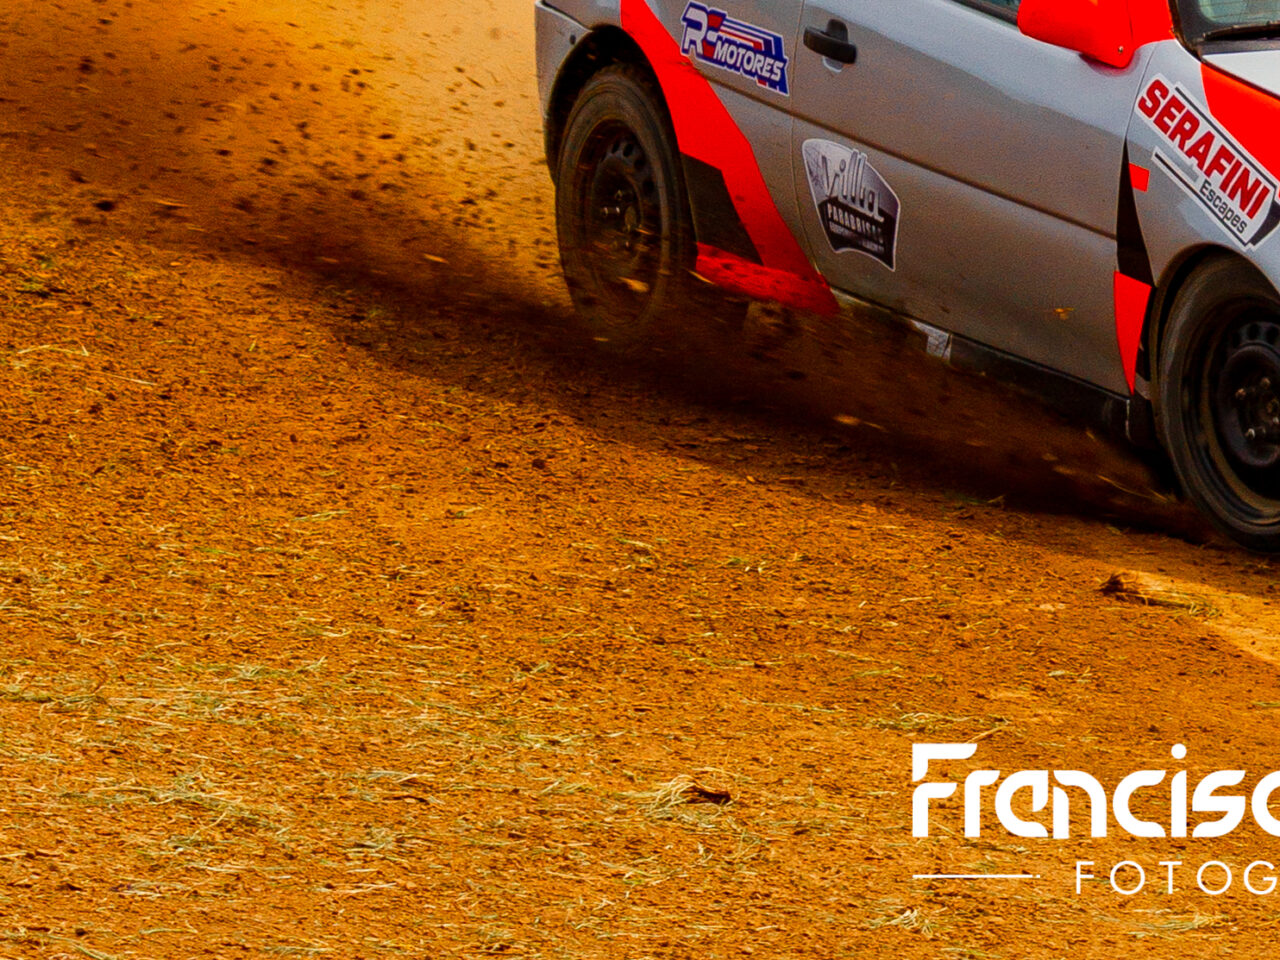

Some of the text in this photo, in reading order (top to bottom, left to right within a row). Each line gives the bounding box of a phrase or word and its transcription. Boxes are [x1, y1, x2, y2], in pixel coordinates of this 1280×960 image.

[713, 40, 784, 82] MOTORES
[1137, 78, 1271, 220] SERAFINI
[820, 149, 886, 223] Villa
[1199, 178, 1249, 235] Escapes
